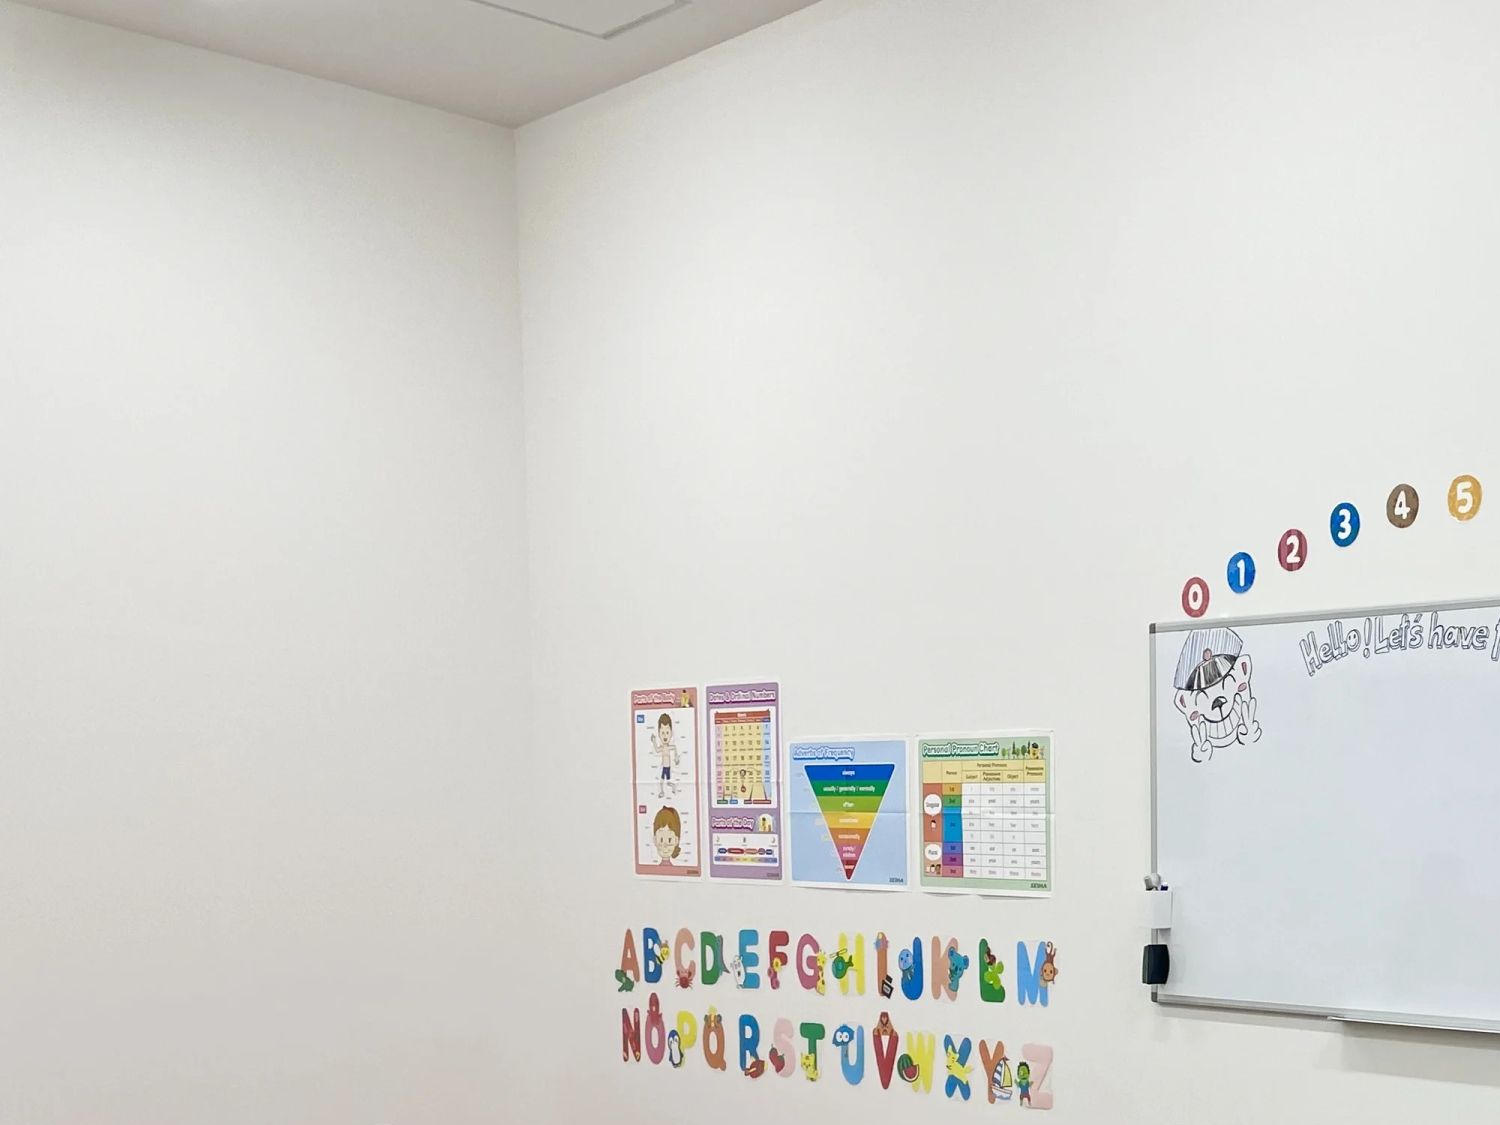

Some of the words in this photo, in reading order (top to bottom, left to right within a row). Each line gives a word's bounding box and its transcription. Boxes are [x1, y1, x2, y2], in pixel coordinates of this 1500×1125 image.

[1188, 583, 1203, 611] 0
[1237, 559, 1246, 587] 1
[1286, 534, 1301, 564] 2
[1337, 508, 1352, 540] 3
[1394, 490, 1411, 520] 4
[1456, 481, 1473, 513] 5
[1374, 612, 1423, 655] Let's
[1427, 611, 1490, 650] have
[922, 742, 951, 757] Personal
[951, 742, 980, 756] Pronoun
[980, 741, 999, 755] Chart
[619, 928, 640, 984] A
[643, 927, 662, 983] B
[674, 928, 696, 988] C
[700, 931, 722, 985] D
[796, 933, 821, 991] G
[1016, 940, 1049, 1007] M
[622, 1007, 641, 1062] N
[799, 1022, 826, 1080] T
[872, 1026, 899, 1090] V
[978, 1039, 1006, 1104] Y
